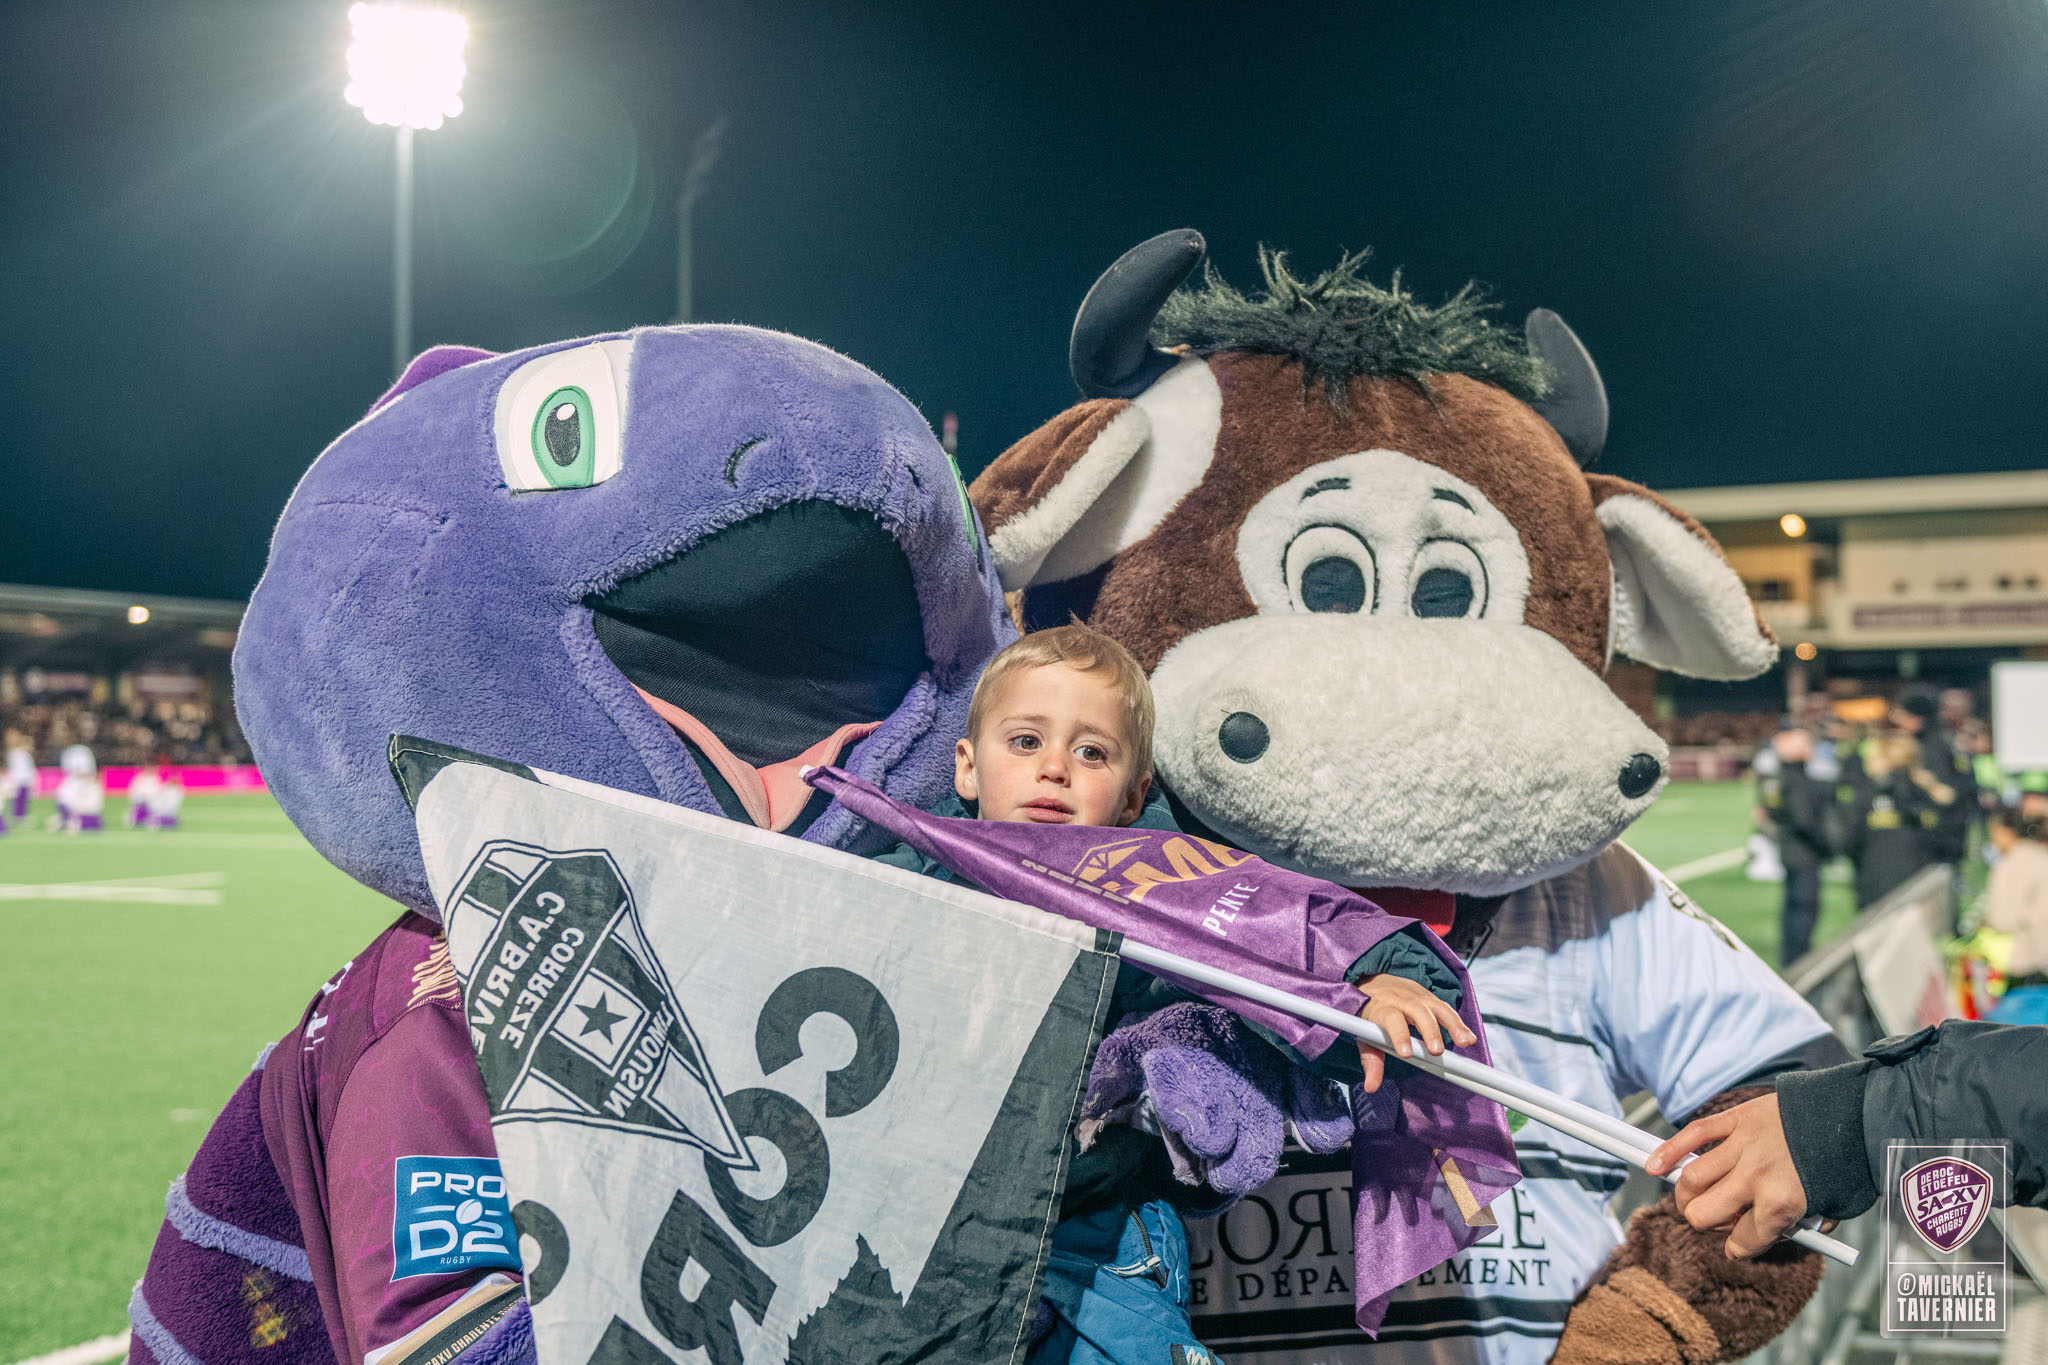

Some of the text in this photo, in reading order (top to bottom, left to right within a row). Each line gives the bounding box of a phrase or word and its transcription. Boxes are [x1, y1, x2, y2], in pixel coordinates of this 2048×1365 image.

[411, 1171, 506, 1198] PRO
[409, 1220, 510, 1260] D2
[440, 1256, 472, 1264] RUGBY
[1236, 1258, 1551, 1301] DÉPAEMENT
